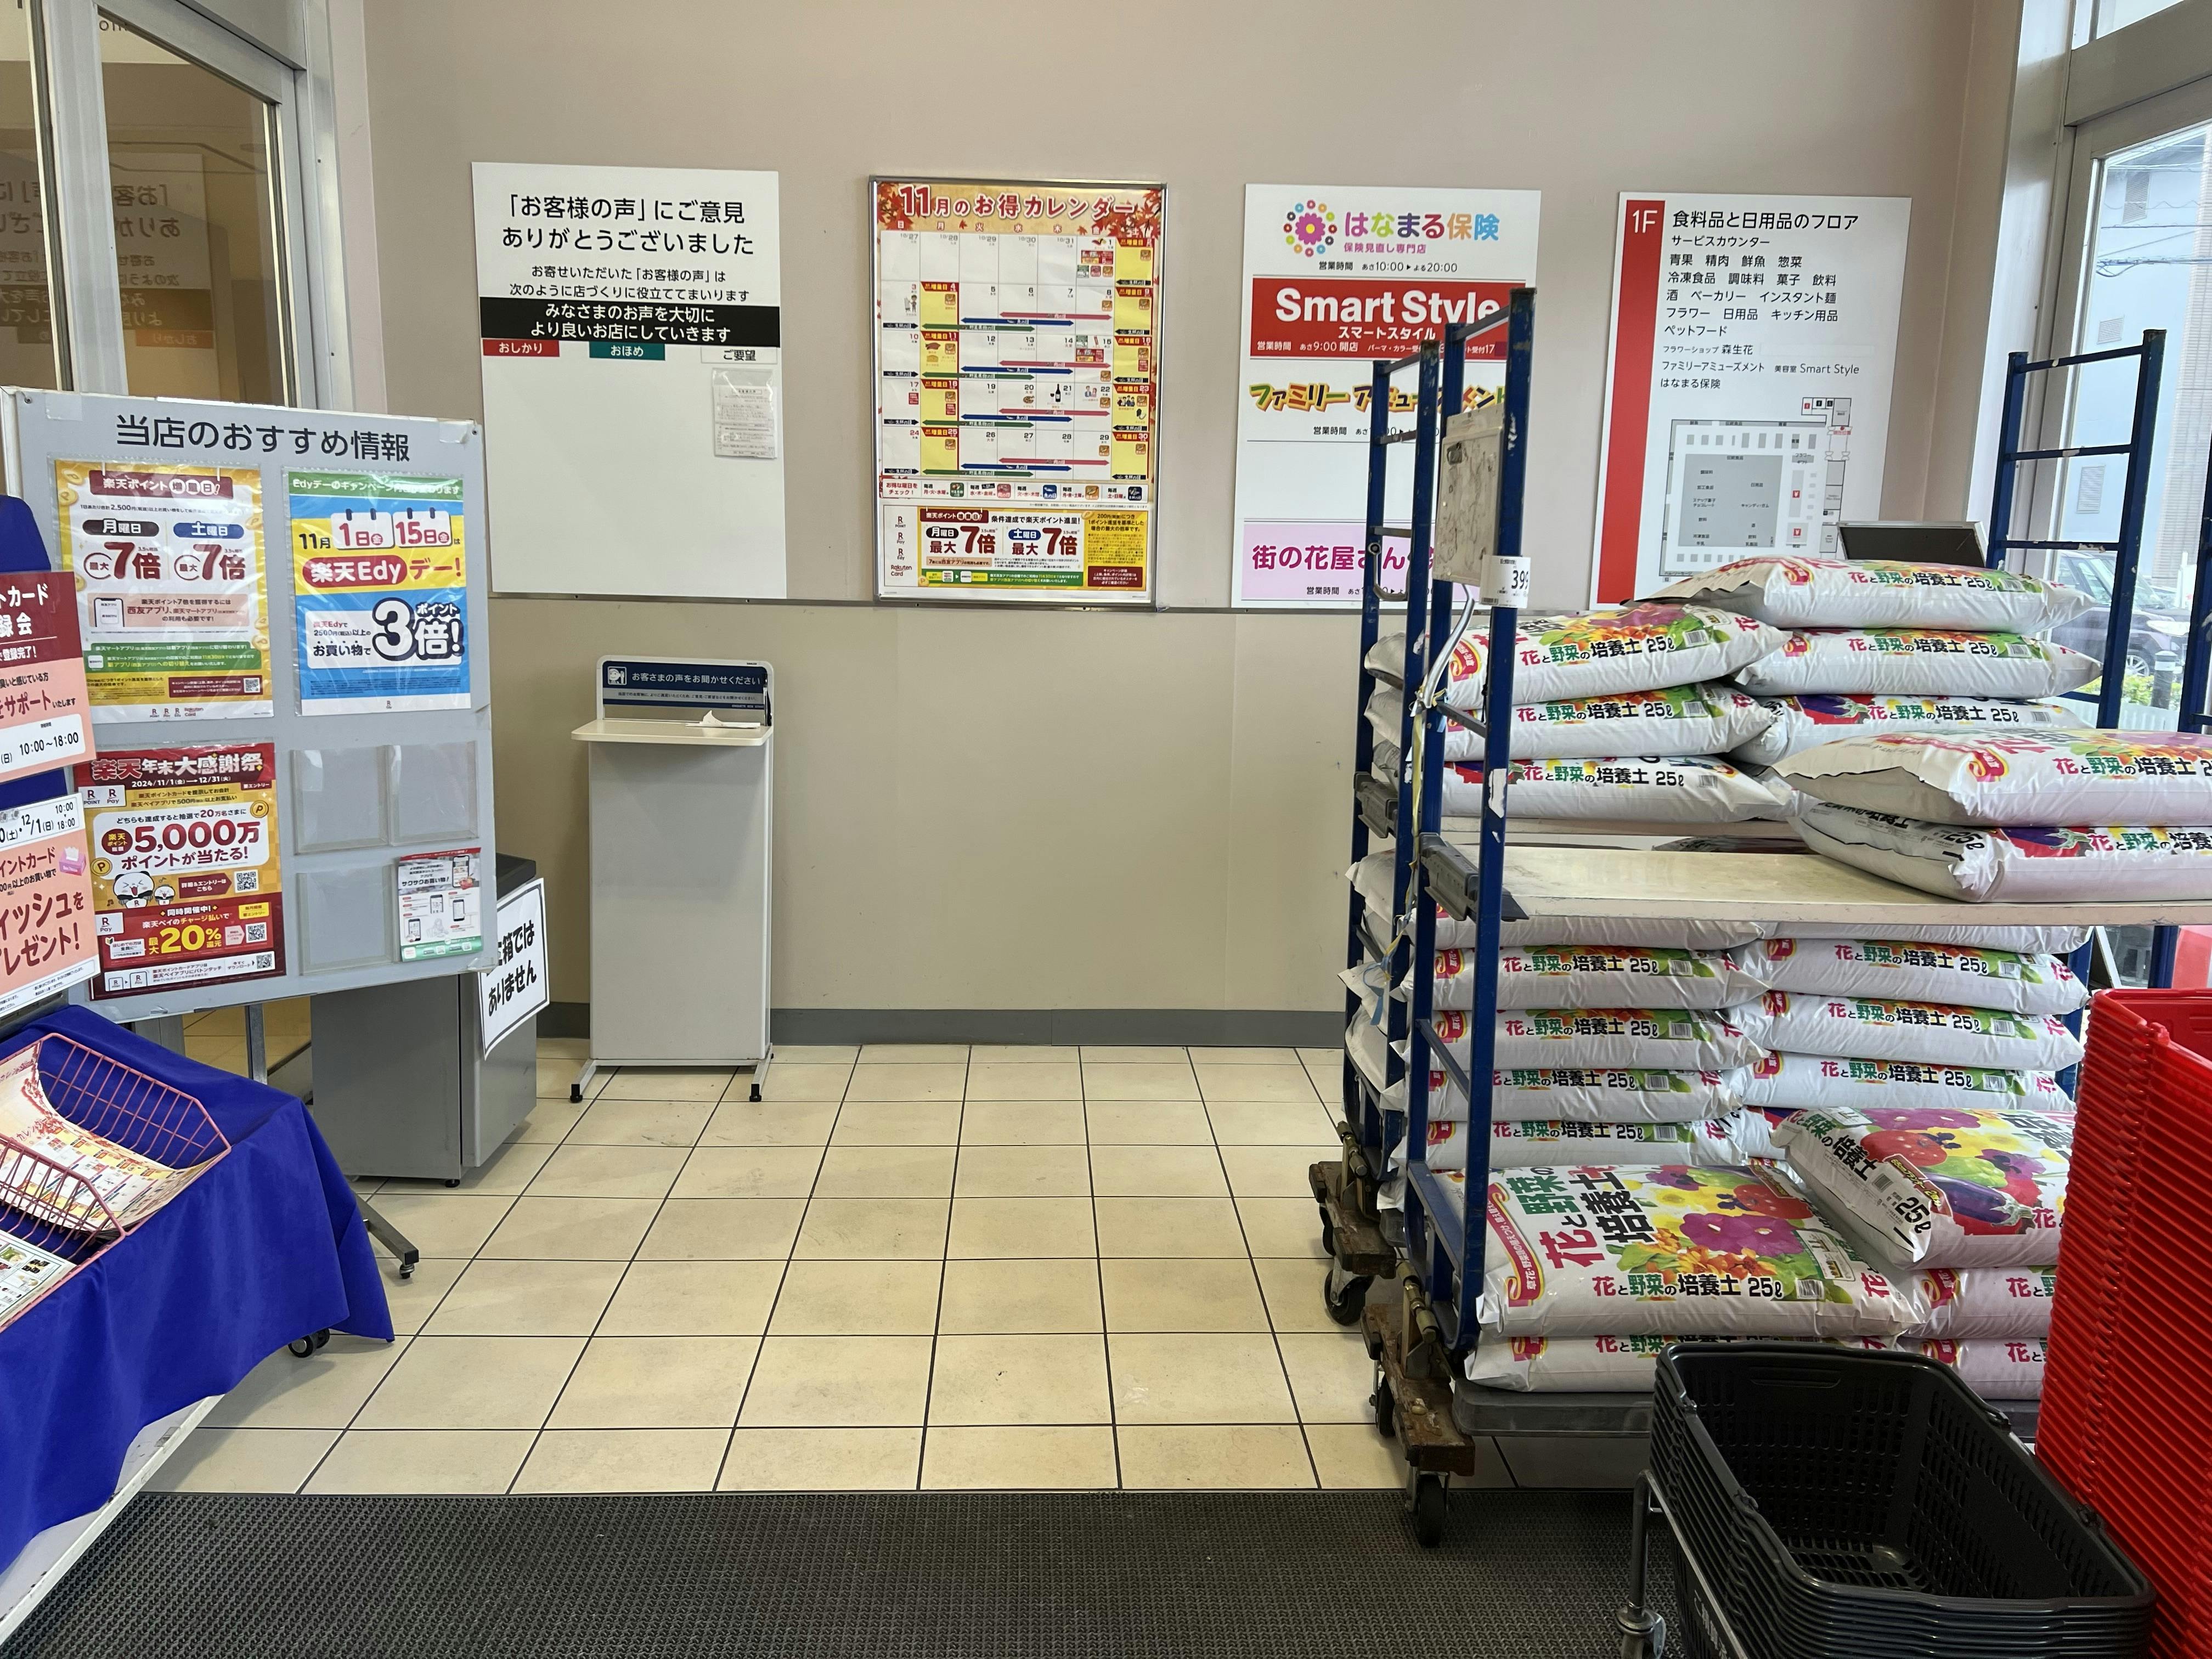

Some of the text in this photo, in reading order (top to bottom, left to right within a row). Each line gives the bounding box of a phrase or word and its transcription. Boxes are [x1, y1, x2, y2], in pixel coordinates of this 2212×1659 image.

[510, 194, 745, 224] 「お客様の声」にご意見
[899, 185, 1136, 221] 11月のお得カレンダー
[936, 222, 945, 231] 月
[975, 223, 984, 232] 火
[1345, 212, 1500, 241] はなまる保険
[1632, 209, 1658, 234] 1F
[1672, 210, 1859, 230] 食料品と日用品のフロア
[502, 227, 754, 255] ありがとうございました
[1344, 241, 1427, 255] 保険見直し専門店
[1672, 235, 1770, 248] サービスカウンター
[1318, 260, 1458, 273] 営業時間 あさ10:00 よる20:00
[1669, 253, 1802, 268] 青果 精肉 鮮魚 惣菜
[531, 265, 726, 283] お寄せいただいた「お客様の声」は
[1667, 272, 1837, 287] 冷凍食品 調味料 菓子 飲料
[509, 283, 749, 302] 次のように店づくりに役立ててまいります
[1666, 289, 1837, 304] 酒 ベーカリー インスタント麺
[545, 303, 715, 323] みなさまのお声を大切に
[1275, 286, 1501, 325] Smart Style
[1666, 308, 1838, 322] フラワー 日用品 キッチン用品
[530, 321, 731, 343] より良いお店にしていきます
[1338, 326, 1436, 341] スマートスタイル
[1664, 325, 1728, 337] ペットフード
[498, 342, 543, 354] おしかり
[610, 345, 644, 357] おほめ
[723, 349, 756, 362] ご要望
[1257, 341, 1358, 353] 営業時間 あさ9:00 開店
[1663, 343, 1753, 356] フラワーショップ 森生花
[1662, 361, 1860, 376] ファミリーアミューズメント 美容室 Smart Style
[1661, 377, 1721, 390] はなまる保険
[1249, 382, 1351, 413] ファミリー
[116, 414, 410, 462] 当店のおすすめ情報
[1313, 426, 1347, 436] 営業時間
[103, 518, 229, 537] 月曜日 土曜日
[1013, 528, 1037, 539] 土曜日
[298, 533, 331, 549] 11月
[929, 525, 996, 554] 最大 7倍
[1012, 542, 1039, 555] 最大
[1042, 527, 1077, 556] 7倍
[104, 541, 161, 580] 7倍
[193, 544, 246, 581] 7倍
[1849, 570, 1962, 588] 花と野菜の培養土
[1306, 586, 1339, 595] 営業時間
[416, 602, 459, 616] ポイント
[313, 644, 372, 657] お買い物で
[1520, 636, 1643, 667] 花と野菜の培養土
[1849, 636, 1965, 656] 花と野菜の培養土
[631, 672, 761, 686] お客さまの声をお聞かせください
[1516, 702, 1639, 723] 花と野菜の培養土
[1868, 704, 1987, 721] 花と野菜の培養土
[91, 752, 263, 781] 楽天年末大感謝祭
[1523, 766, 1649, 785] 花と野菜の培養土
[2052, 757, 2197, 776] 花と野菜の培養土
[55, 804, 74, 815] 10:00
[57, 820, 76, 831] 18:00
[134, 820, 261, 854] 5,000万
[121, 846, 249, 871] ポイントが当たる!
[142, 911, 230, 929] 楽天ペイのチャージ払いで
[167, 905, 212, 918] 同時開催中!
[160, 924, 222, 953] 20%
[0, 922, 80, 977] レゼント!
[1835, 945, 1955, 970] 花と野菜の培養土
[1503, 955, 1624, 973] 花と野菜の培養土
[488, 960, 537, 1018] ありません
[1827, 1002, 1947, 1028] 花と野菜の培養土
[1505, 1018, 1625, 1037] 花と野菜の培養土
[1820, 1060, 1939, 1085] 花と野菜の培養土
[1492, 1121, 1611, 1139] 花と野菜の培養土
[1895, 1196, 1932, 1234] 25ℓ
[1592, 1273, 1742, 1299] 花と野菜の培養土
